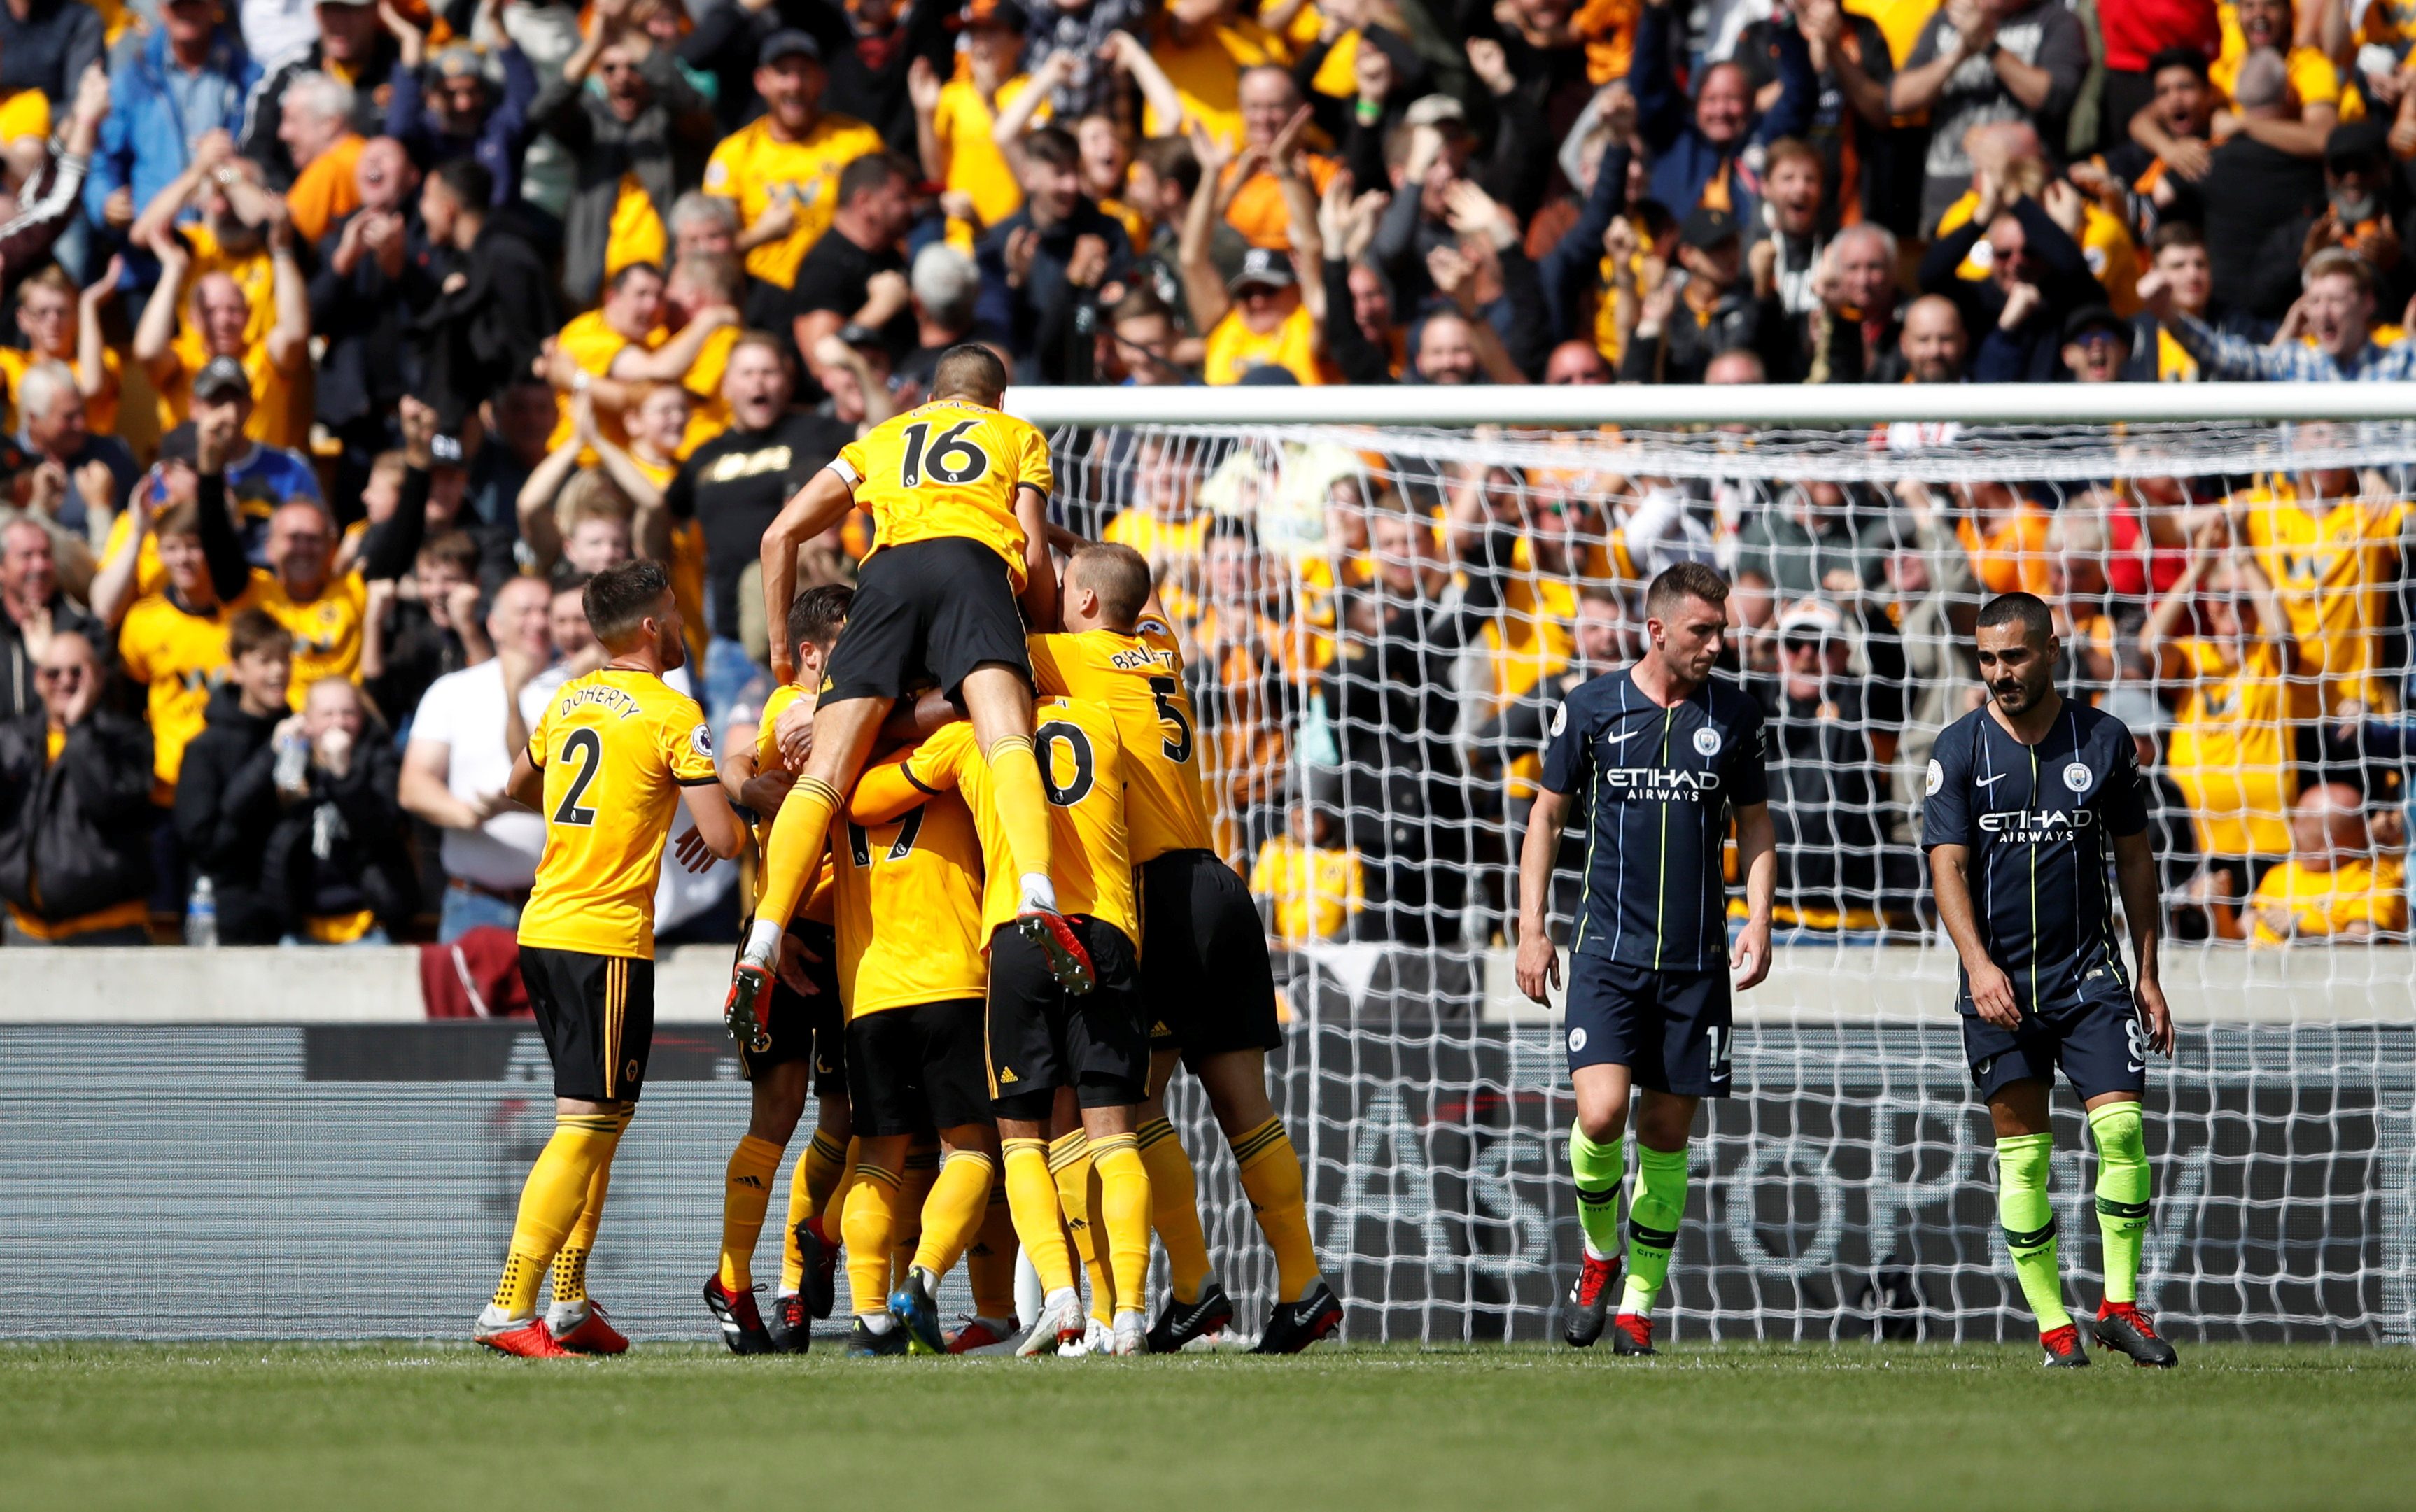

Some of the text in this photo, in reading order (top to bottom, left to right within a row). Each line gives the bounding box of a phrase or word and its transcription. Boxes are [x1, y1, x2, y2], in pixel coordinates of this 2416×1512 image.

[901, 420, 988, 488] 16
[562, 686, 640, 719] DOHERTY
[1149, 677, 1192, 765] 5
[552, 727, 601, 826] 2
[1033, 720, 1096, 807] 0
[1607, 768, 1720, 790] ETIHAD
[1627, 789, 1699, 802] AIRWAYS
[1979, 810, 2093, 831] ETIHAD
[1999, 831, 2074, 842] AIRWAYS
[2125, 1019, 2144, 1061] 8
[1636, 1248, 1664, 1259] CITY
[2023, 1245, 2051, 1258] CITY
